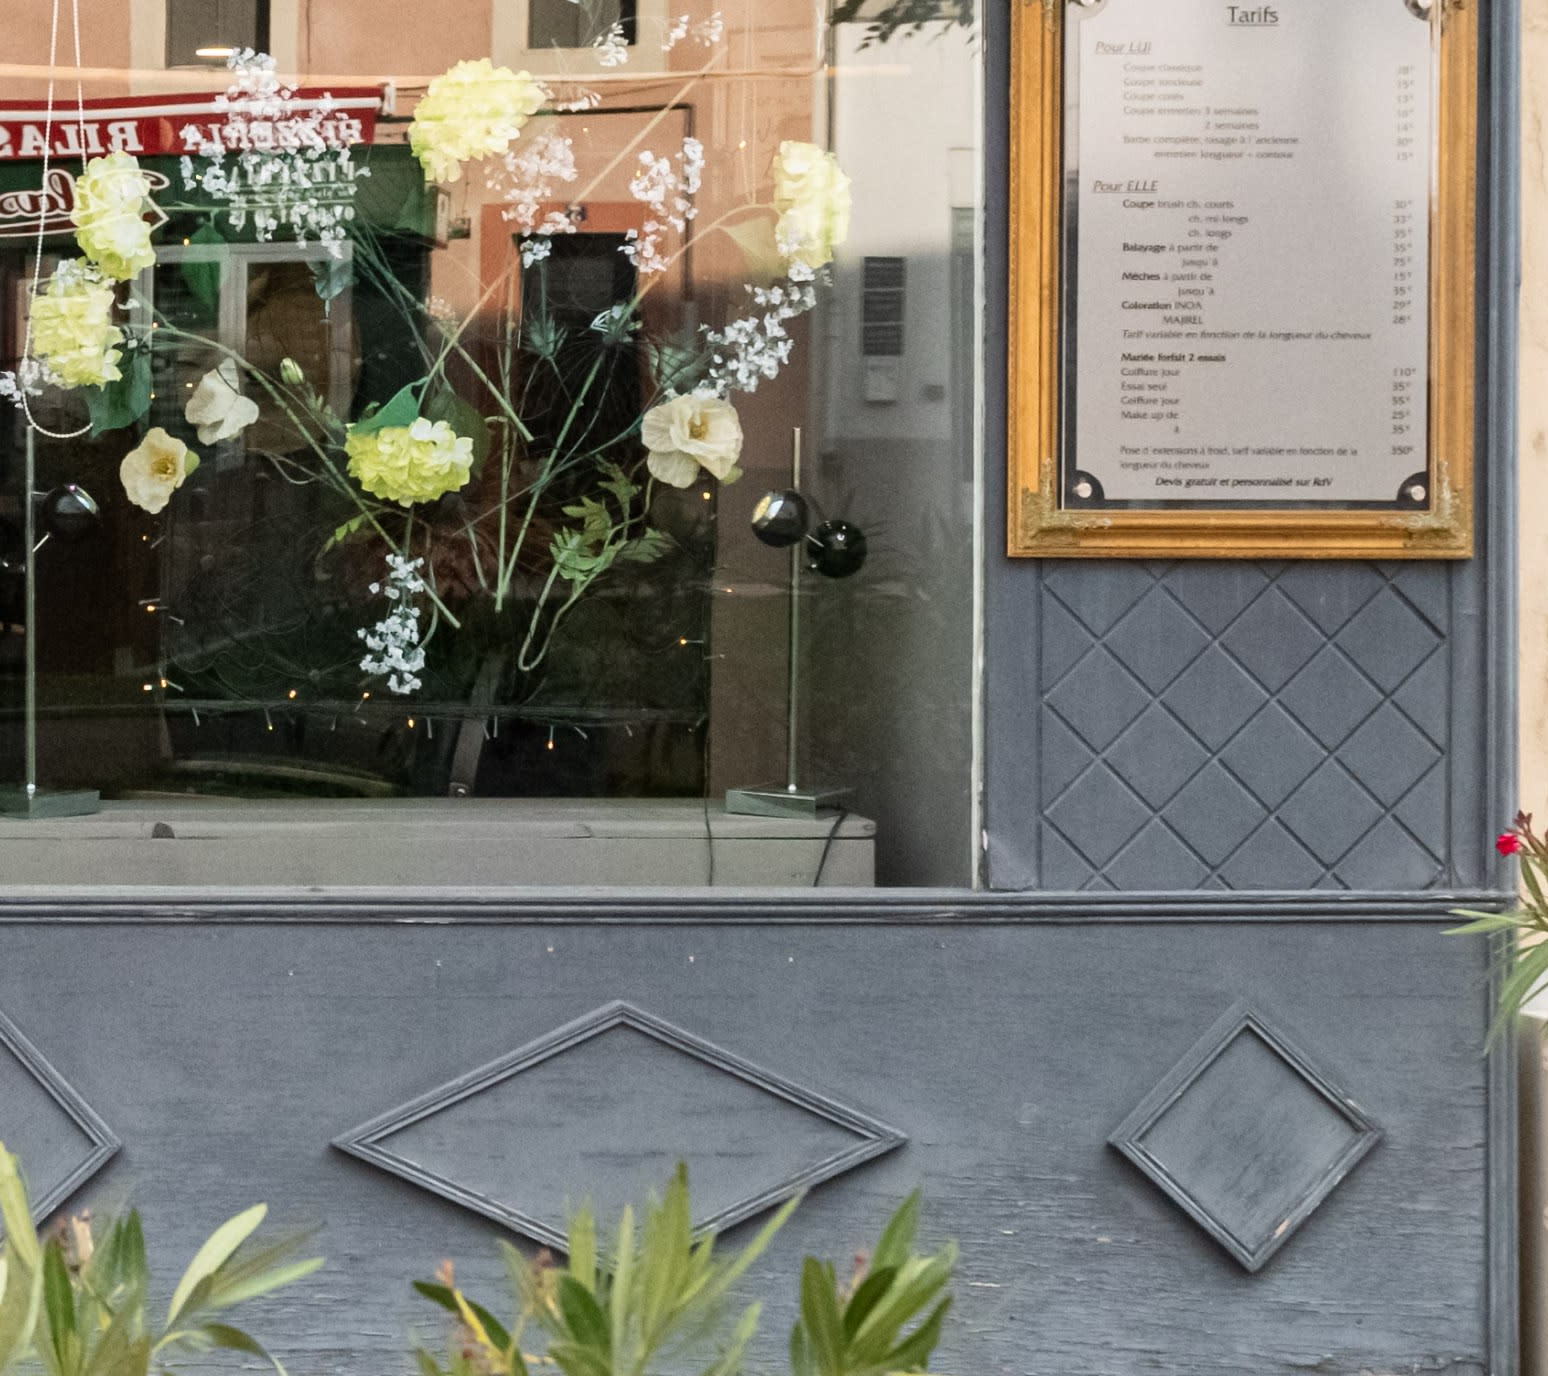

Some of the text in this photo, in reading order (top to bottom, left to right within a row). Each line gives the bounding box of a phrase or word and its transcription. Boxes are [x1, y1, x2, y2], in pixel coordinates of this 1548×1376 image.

[1227, 5, 1280, 24] Tarifs
[1095, 41, 1152, 54] Pour LUI
[1123, 63, 1156, 73] Coupe
[1123, 77, 1156, 88] Coupe
[1123, 92, 1156, 102] Coupe
[1123, 106, 1155, 117] Coupe
[1213, 107, 1259, 116] semaines
[1213, 121, 1260, 130] semaines
[1123, 135, 1151, 145] Barbe
[1200, 150, 1243, 161] longueur
[1093, 180, 1159, 192] Pour ELLE
[1122, 198, 1155, 210] Coupe
[1157, 199, 1185, 209] brush
[1122, 243, 1167, 254] Balayage
[1177, 244, 1203, 253] partir
[1205, 243, 1219, 252] de
[1199, 272, 1213, 281] de
[1121, 301, 1172, 310] Coloration
[1145, 330, 1183, 339] variable
[1200, 330, 1240, 339] fonction
[1242, 330, 1256, 339] de
[1157, 353, 1185, 362] forfait
[1120, 368, 1158, 376] Coiffure
[1161, 368, 1180, 378] jour
[1121, 382, 1145, 391] Essai
[1120, 396, 1158, 405] Coiffure
[1161, 397, 1180, 407] jour
[1121, 411, 1148, 420] Make
[1166, 411, 1179, 419] de
[1251, 447, 1286, 455] variable
[1299, 447, 1334, 456] fonction
[1155, 478, 1183, 486] Devis
[1184, 478, 1217, 488] gratuit
[1295, 479, 1310, 487] sur
